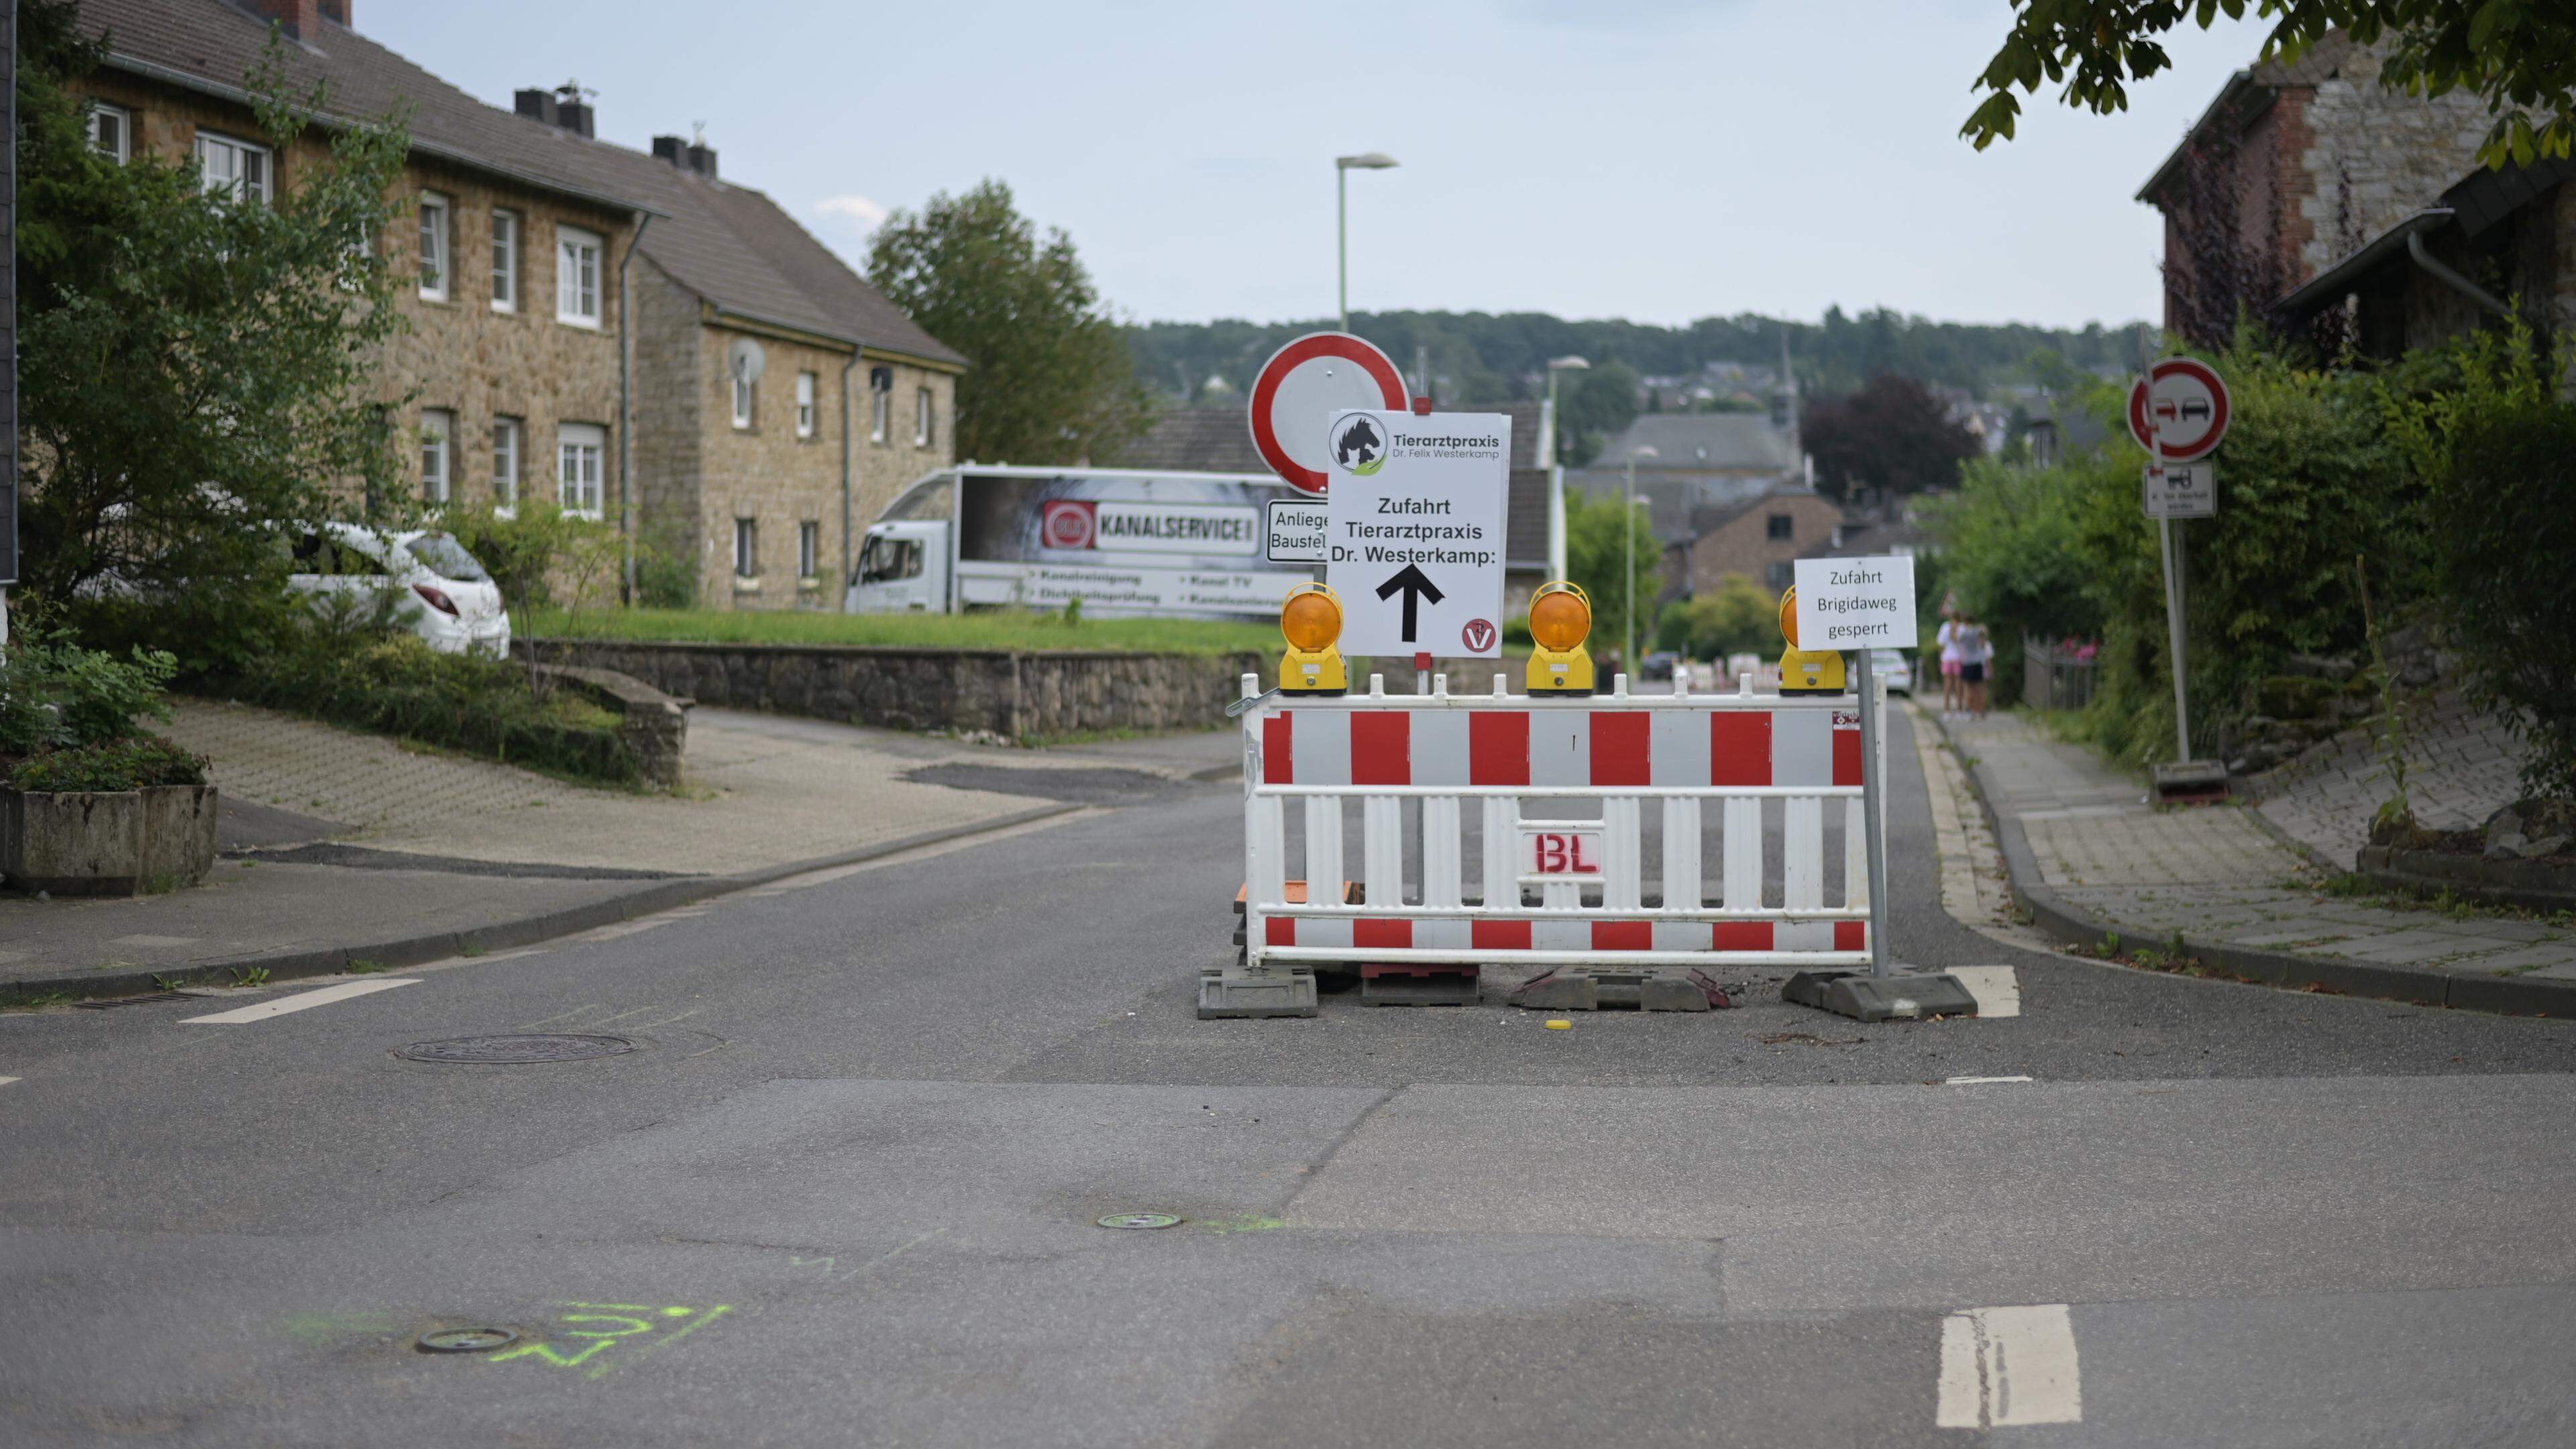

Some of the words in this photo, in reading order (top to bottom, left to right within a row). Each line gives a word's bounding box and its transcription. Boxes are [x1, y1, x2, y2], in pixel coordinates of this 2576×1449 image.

[1394, 434, 1499, 449] Tierarztpraxis
[1393, 449, 1405, 458] Dr.
[1409, 449, 1430, 458] Felix
[1434, 450, 1499, 461] Westerkamp
[1378, 498, 1450, 515] Zufahrt
[1276, 512, 1328, 530] Anliege
[1272, 533, 1326, 548] Baustel
[1346, 522, 1483, 542] Tierarztpraxis
[1332, 546, 1358, 561] Dr.
[1365, 546, 1495, 568] Westerkamp:
[1831, 570, 1882, 585] Zufahrt
[1818, 596, 1896, 613] Brigidaweg
[1829, 623, 1888, 639] gesperrt
[1536, 834, 1597, 872] BL
